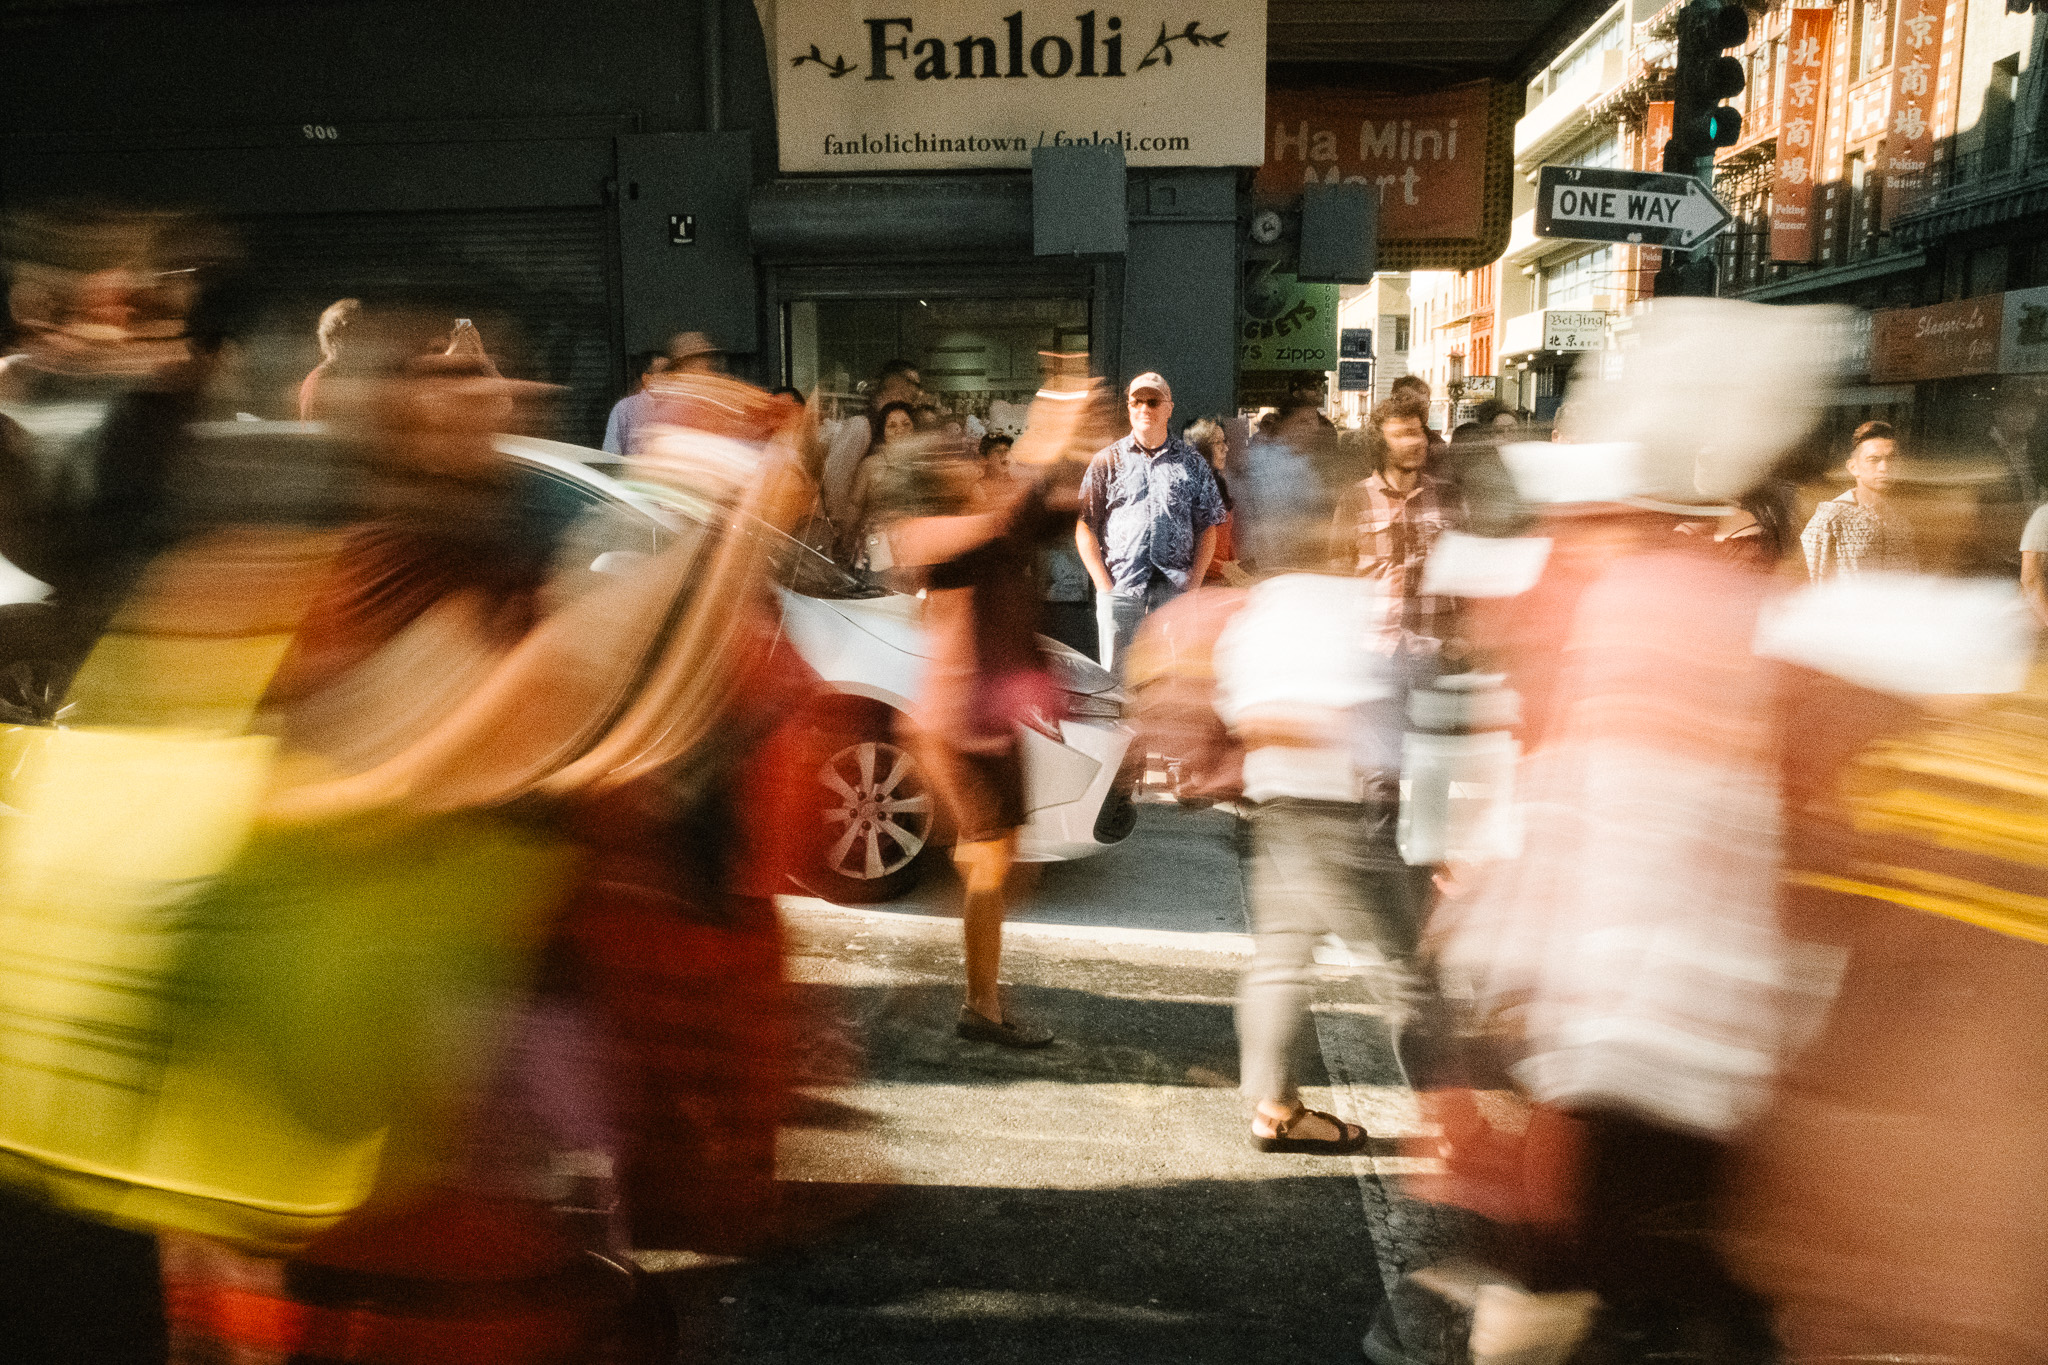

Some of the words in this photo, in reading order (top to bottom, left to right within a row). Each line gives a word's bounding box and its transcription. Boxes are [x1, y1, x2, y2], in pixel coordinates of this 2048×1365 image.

[863, 10, 1126, 81] Fanloli
[1779, 36, 1822, 185] 北京商場
[302, 124, 338, 140] 800
[1273, 120, 1339, 161] Ha
[1359, 118, 1458, 161] Mini
[823, 131, 1028, 156] fanlolichinatown
[1888, 157, 1927, 172] Peking
[1559, 189, 1617, 219] ONE
[1627, 194, 1682, 224] WAY
[1775, 203, 1807, 217] Peking
[1641, 252, 1663, 262] Pekin
[1275, 345, 1326, 364] zippo
